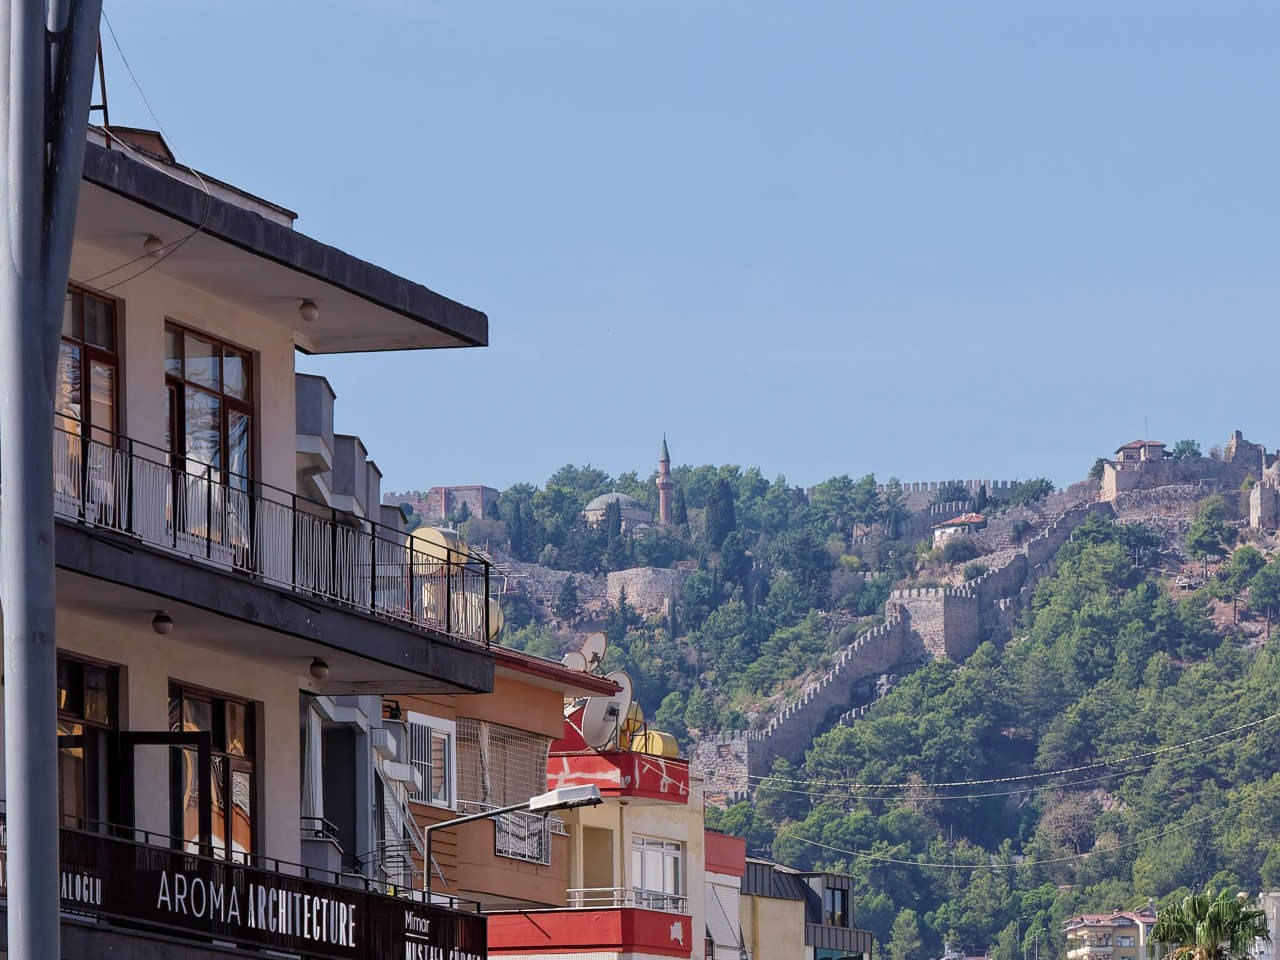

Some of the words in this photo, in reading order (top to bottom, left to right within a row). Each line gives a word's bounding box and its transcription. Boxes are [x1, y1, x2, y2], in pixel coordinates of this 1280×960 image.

[157, 870, 241, 926] AROMA
[247, 883, 356, 948] ARCHITECTURE
[405, 910, 430, 933] Mimar
